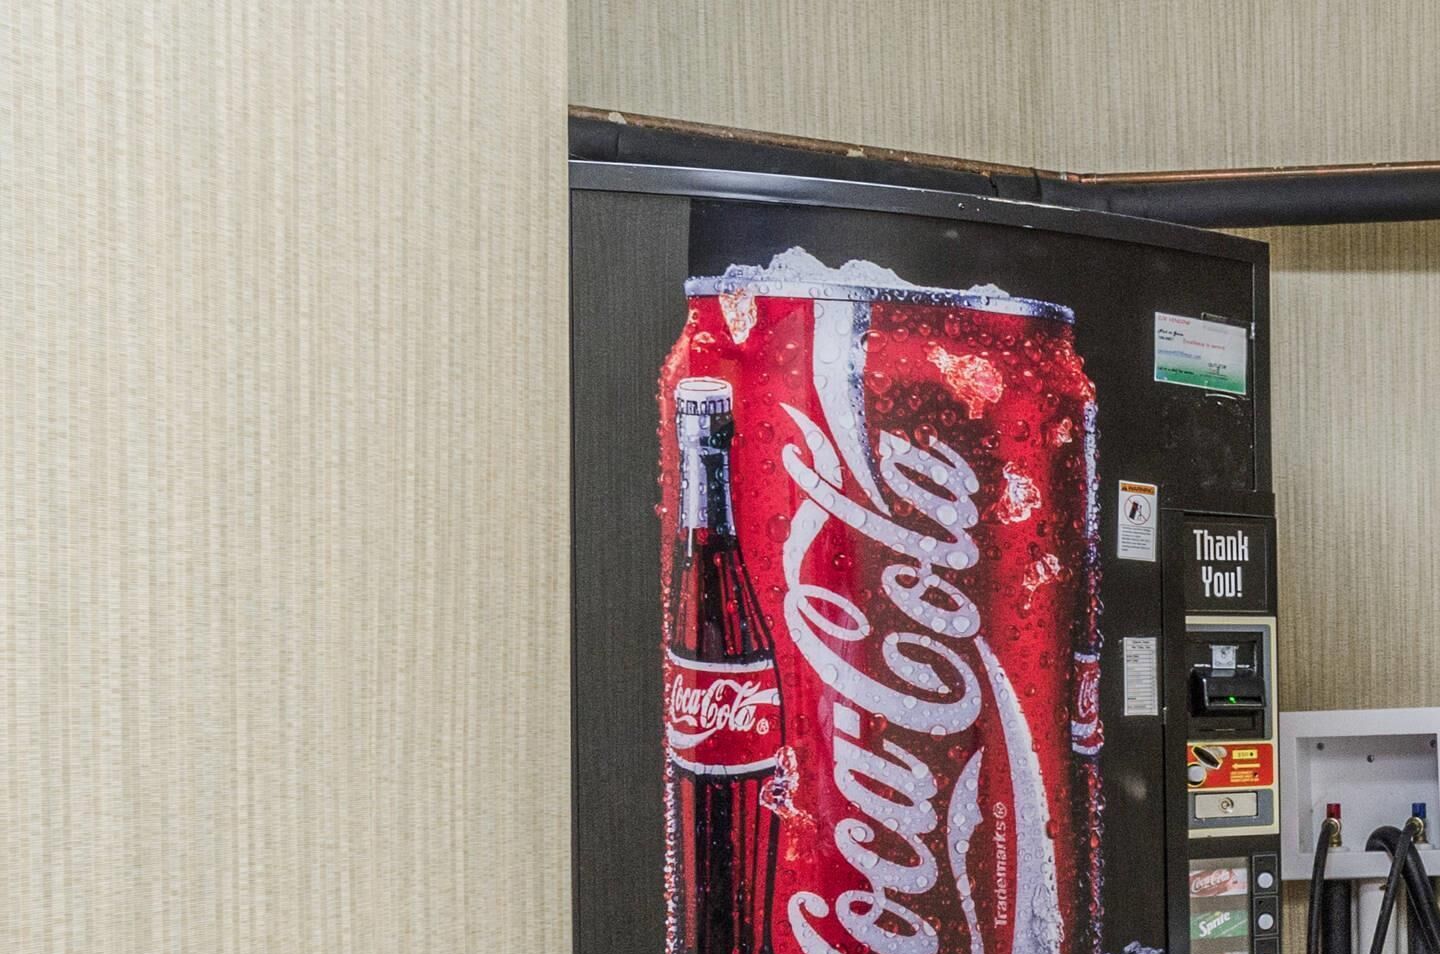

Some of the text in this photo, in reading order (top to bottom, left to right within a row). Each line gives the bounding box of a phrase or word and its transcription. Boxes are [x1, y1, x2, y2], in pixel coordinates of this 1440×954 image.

[1193, 529, 1249, 561] Thank
[1201, 566, 1243, 597] You!
[1198, 911, 1231, 937] Sprite
